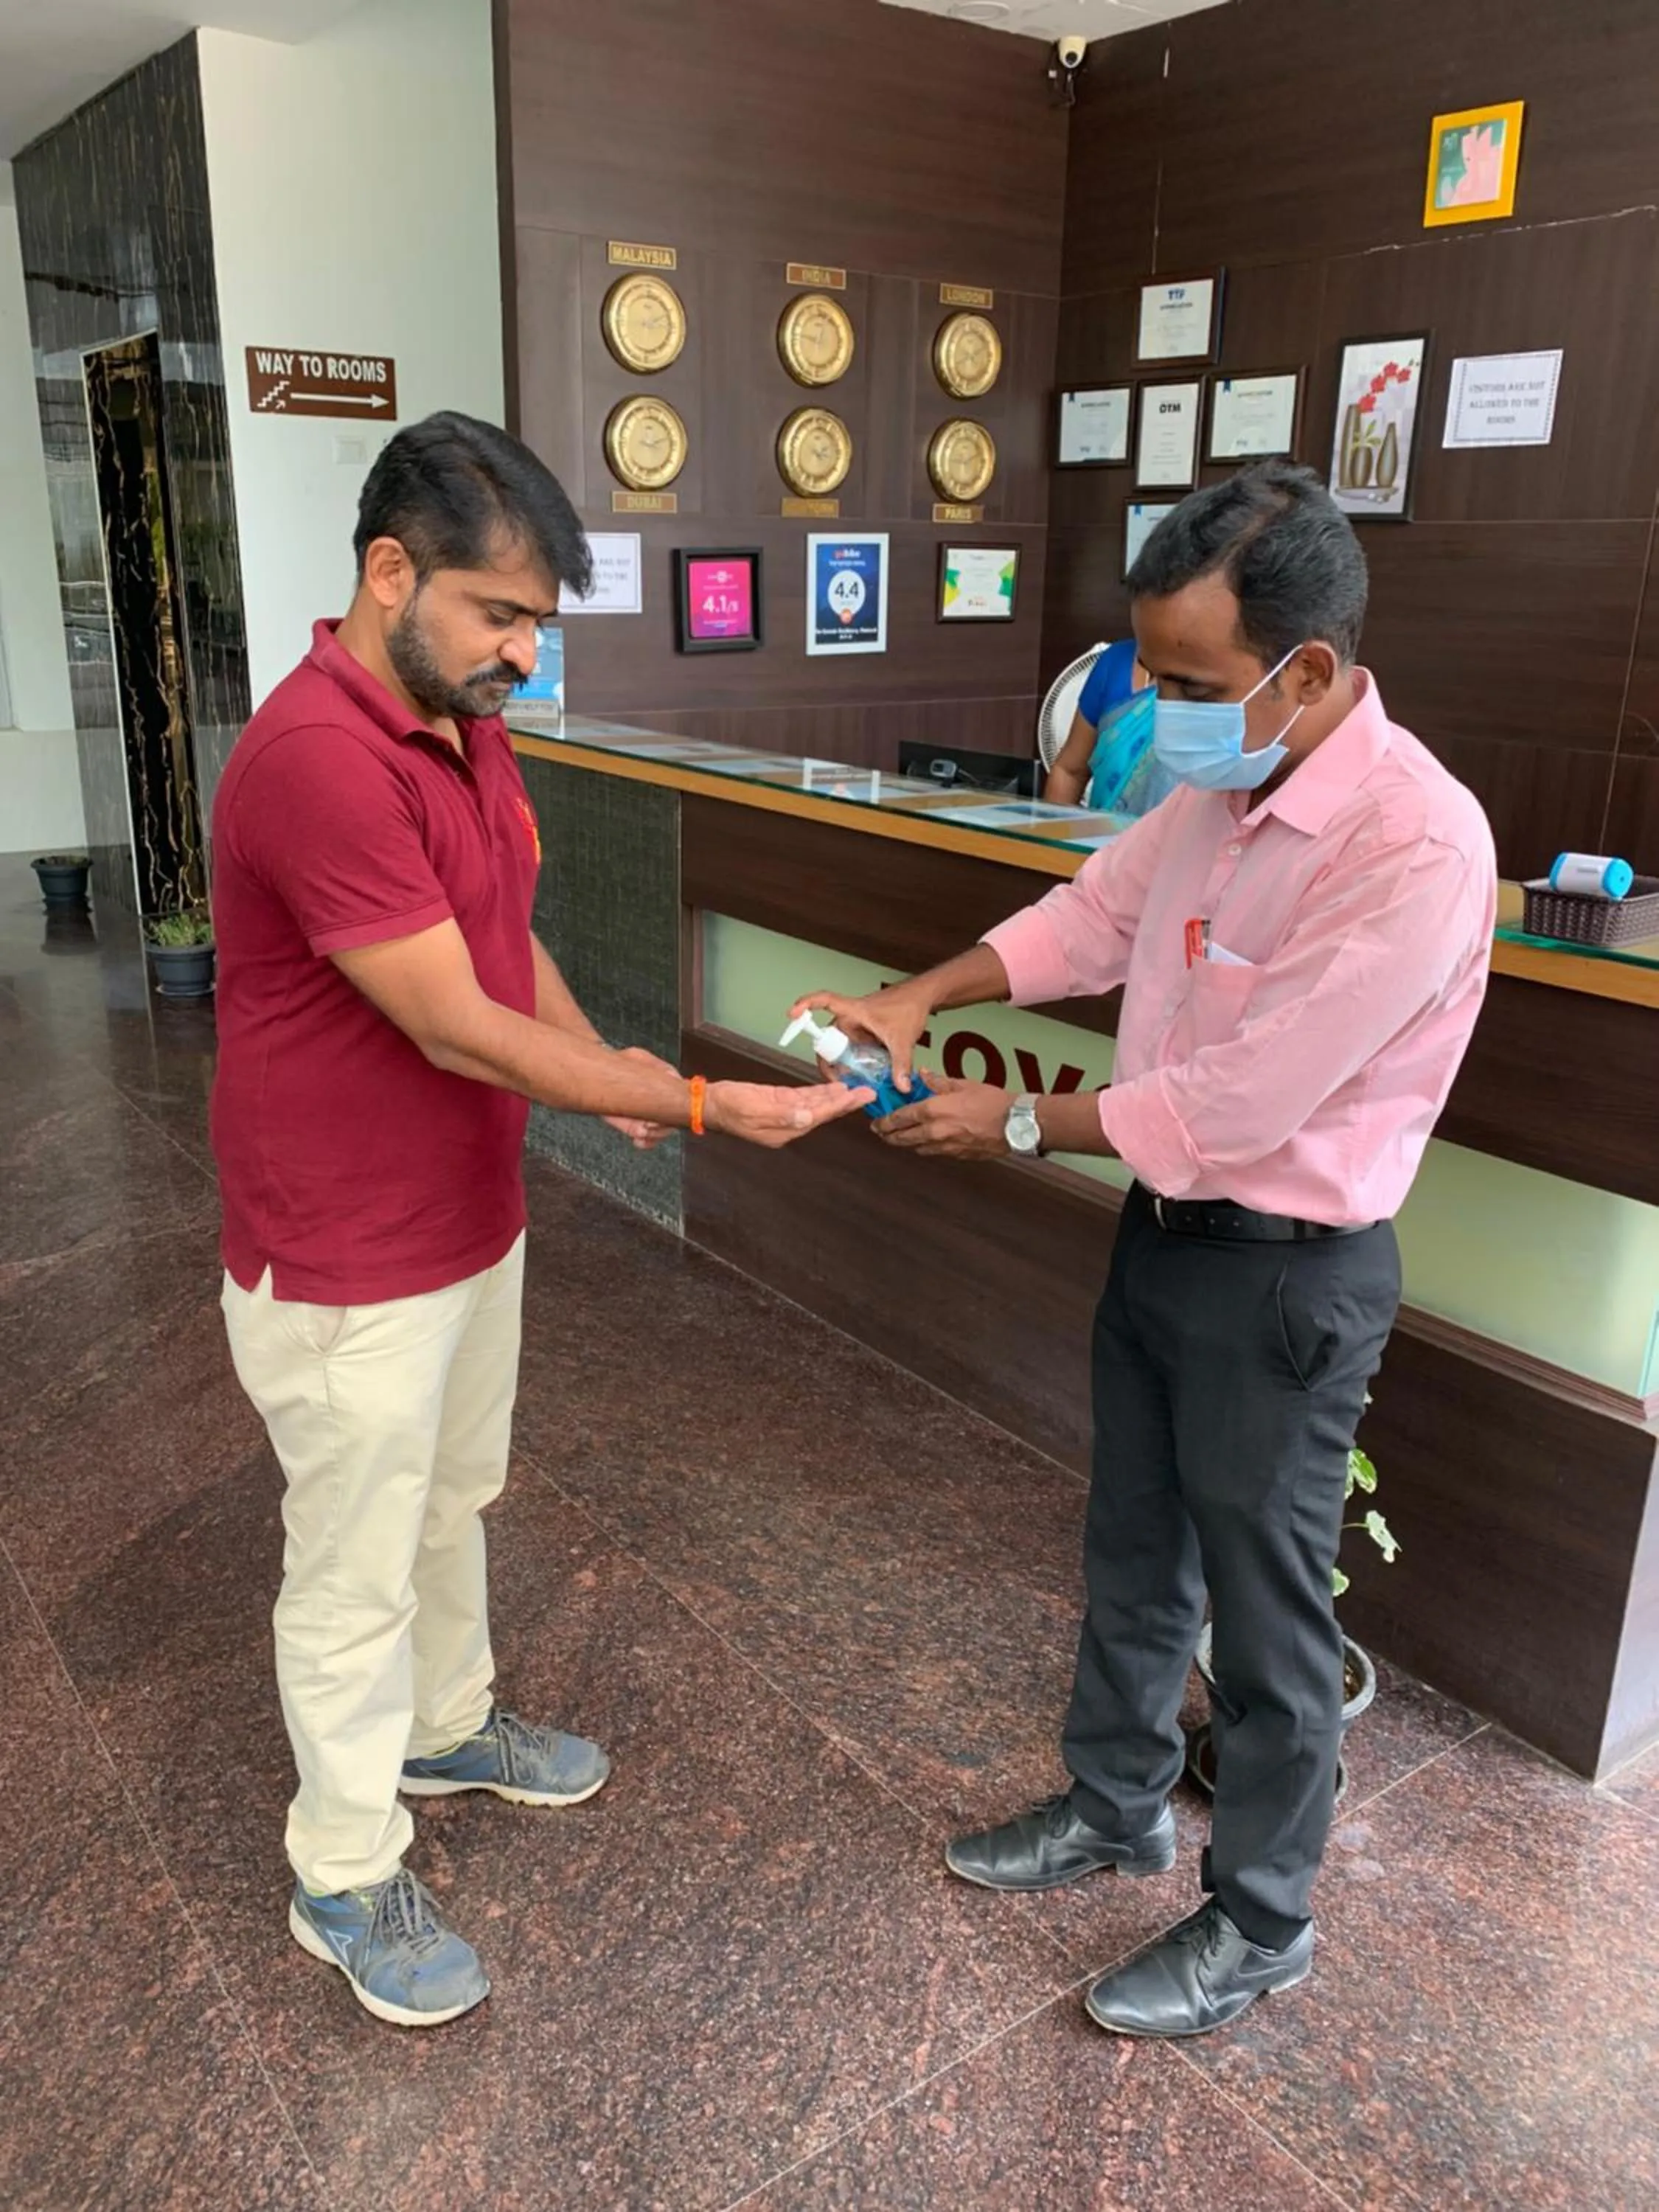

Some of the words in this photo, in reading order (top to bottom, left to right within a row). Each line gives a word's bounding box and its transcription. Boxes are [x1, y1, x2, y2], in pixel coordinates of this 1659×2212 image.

[612, 246, 672, 266] MALAYSIA
[946, 288, 985, 304] LONDON
[255, 351, 294, 375] WAY
[299, 354, 323, 378] TO
[326, 357, 386, 383] ROOMS
[1158, 403, 1181, 414] OTM
[627, 495, 661, 510] DUBAI
[945, 507, 972, 521] PARIS
[834, 581, 860, 599] 4.4
